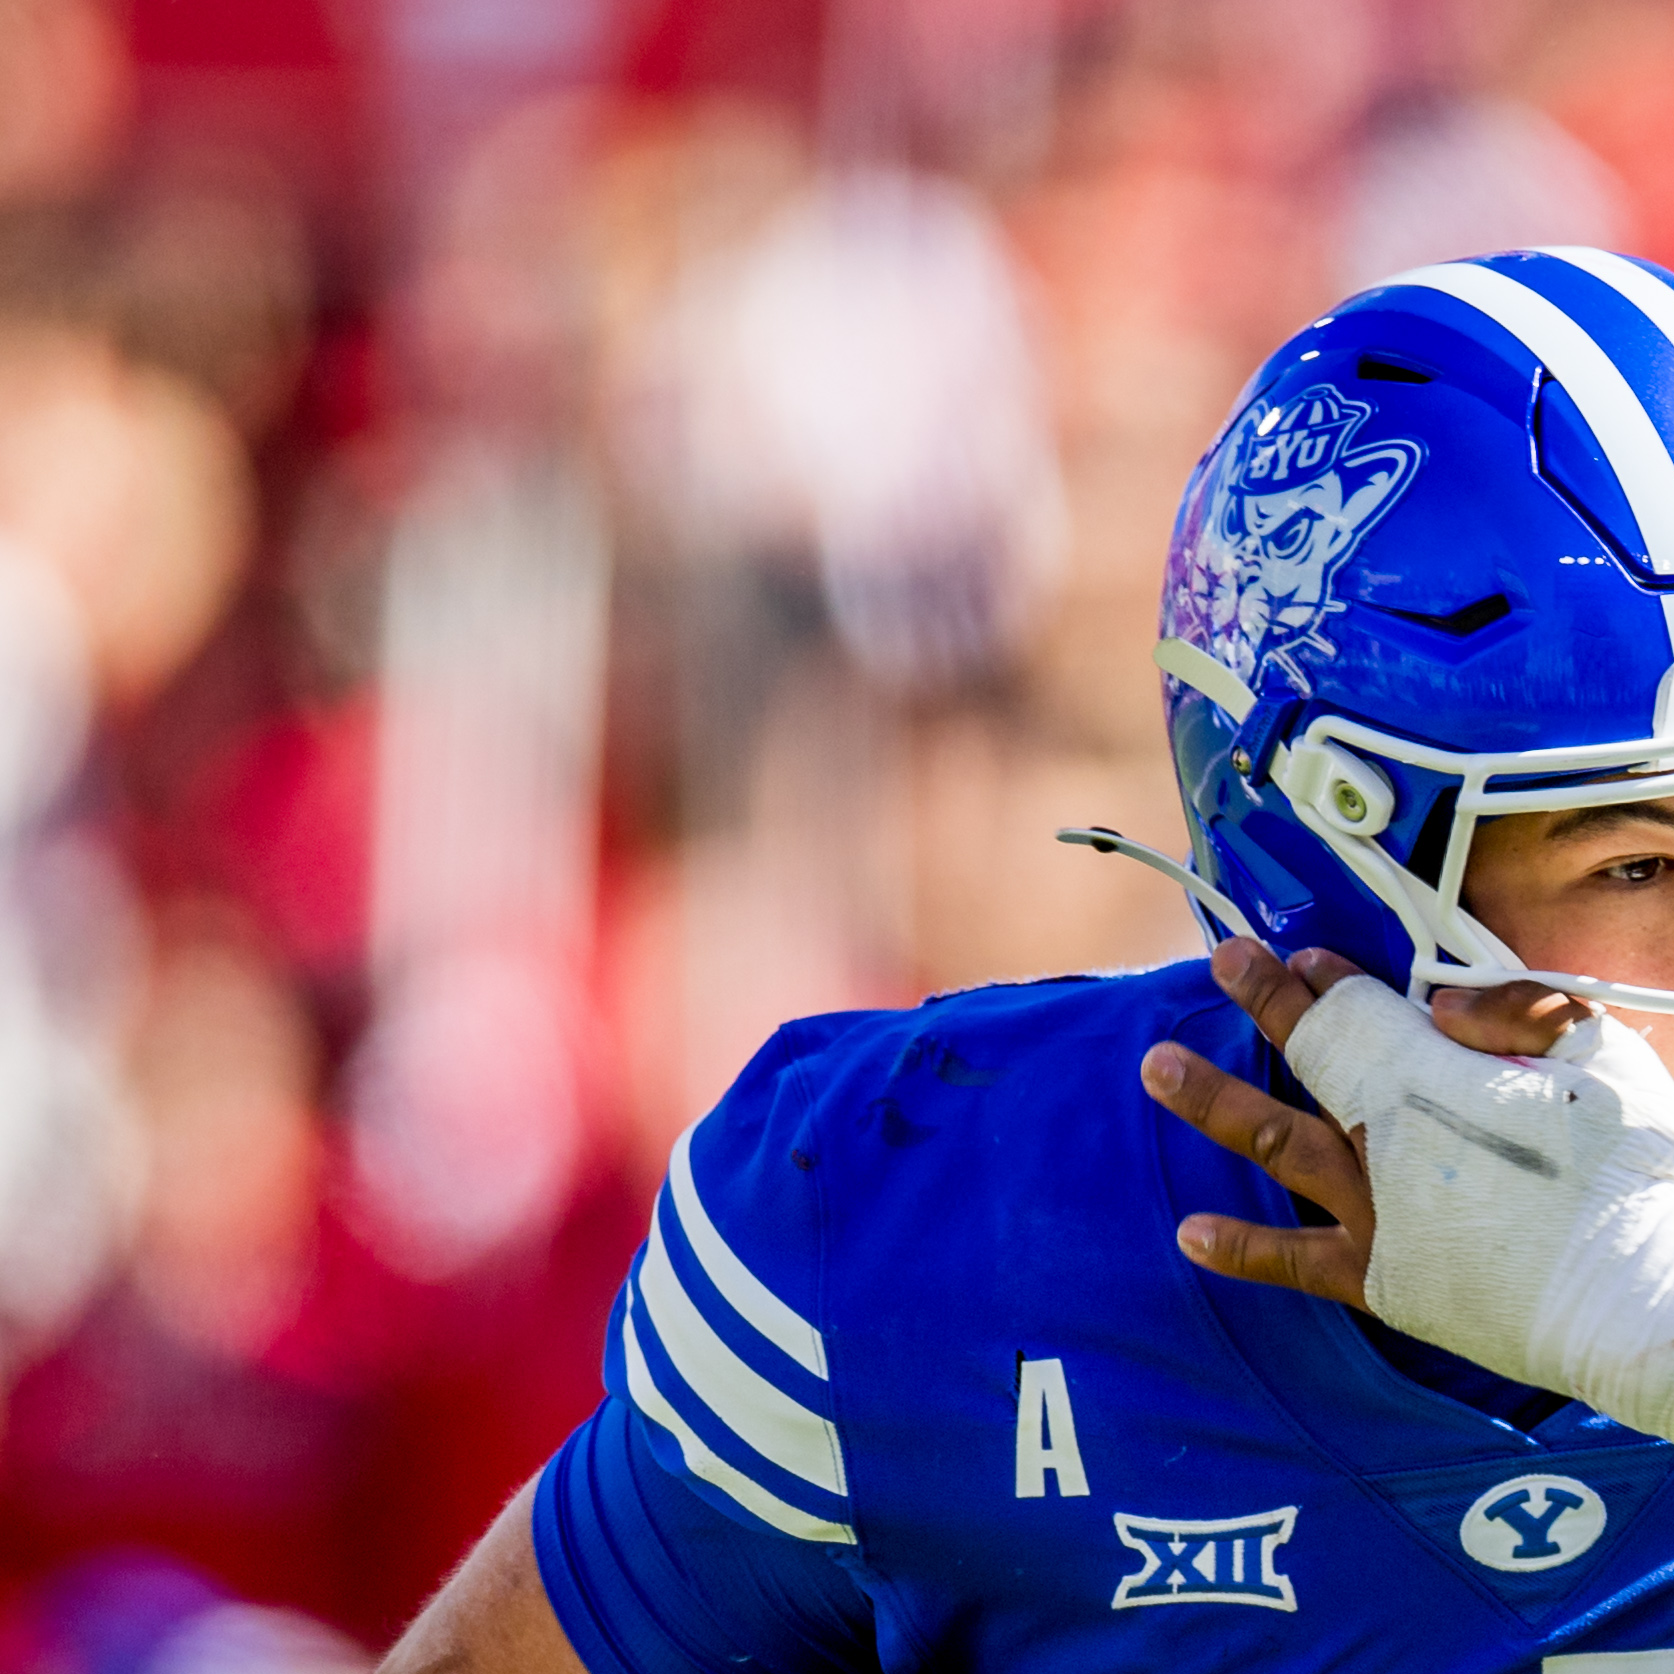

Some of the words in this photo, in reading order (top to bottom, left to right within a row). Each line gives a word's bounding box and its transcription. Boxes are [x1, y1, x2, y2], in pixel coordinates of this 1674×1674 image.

[1249, 429, 1331, 481] BYU
[1016, 1358, 1090, 1498] A
[1483, 1487, 1582, 1559] Y
